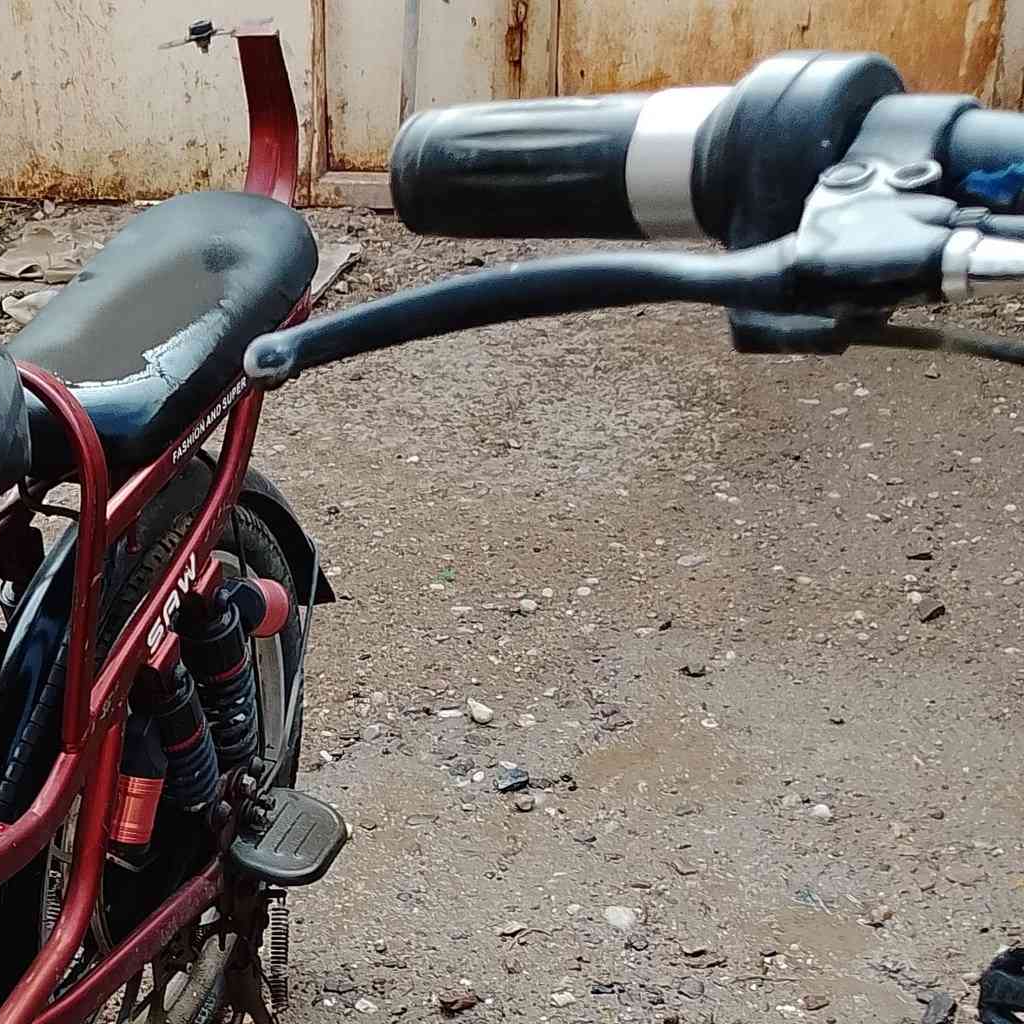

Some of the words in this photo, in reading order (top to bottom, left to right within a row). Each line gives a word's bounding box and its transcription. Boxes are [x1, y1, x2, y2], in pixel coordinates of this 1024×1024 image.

[172, 419, 206, 465] FASHION
[205, 403, 223, 428] AND
[222, 376, 247, 410] SUPER
[147, 551, 196, 654] SAW
